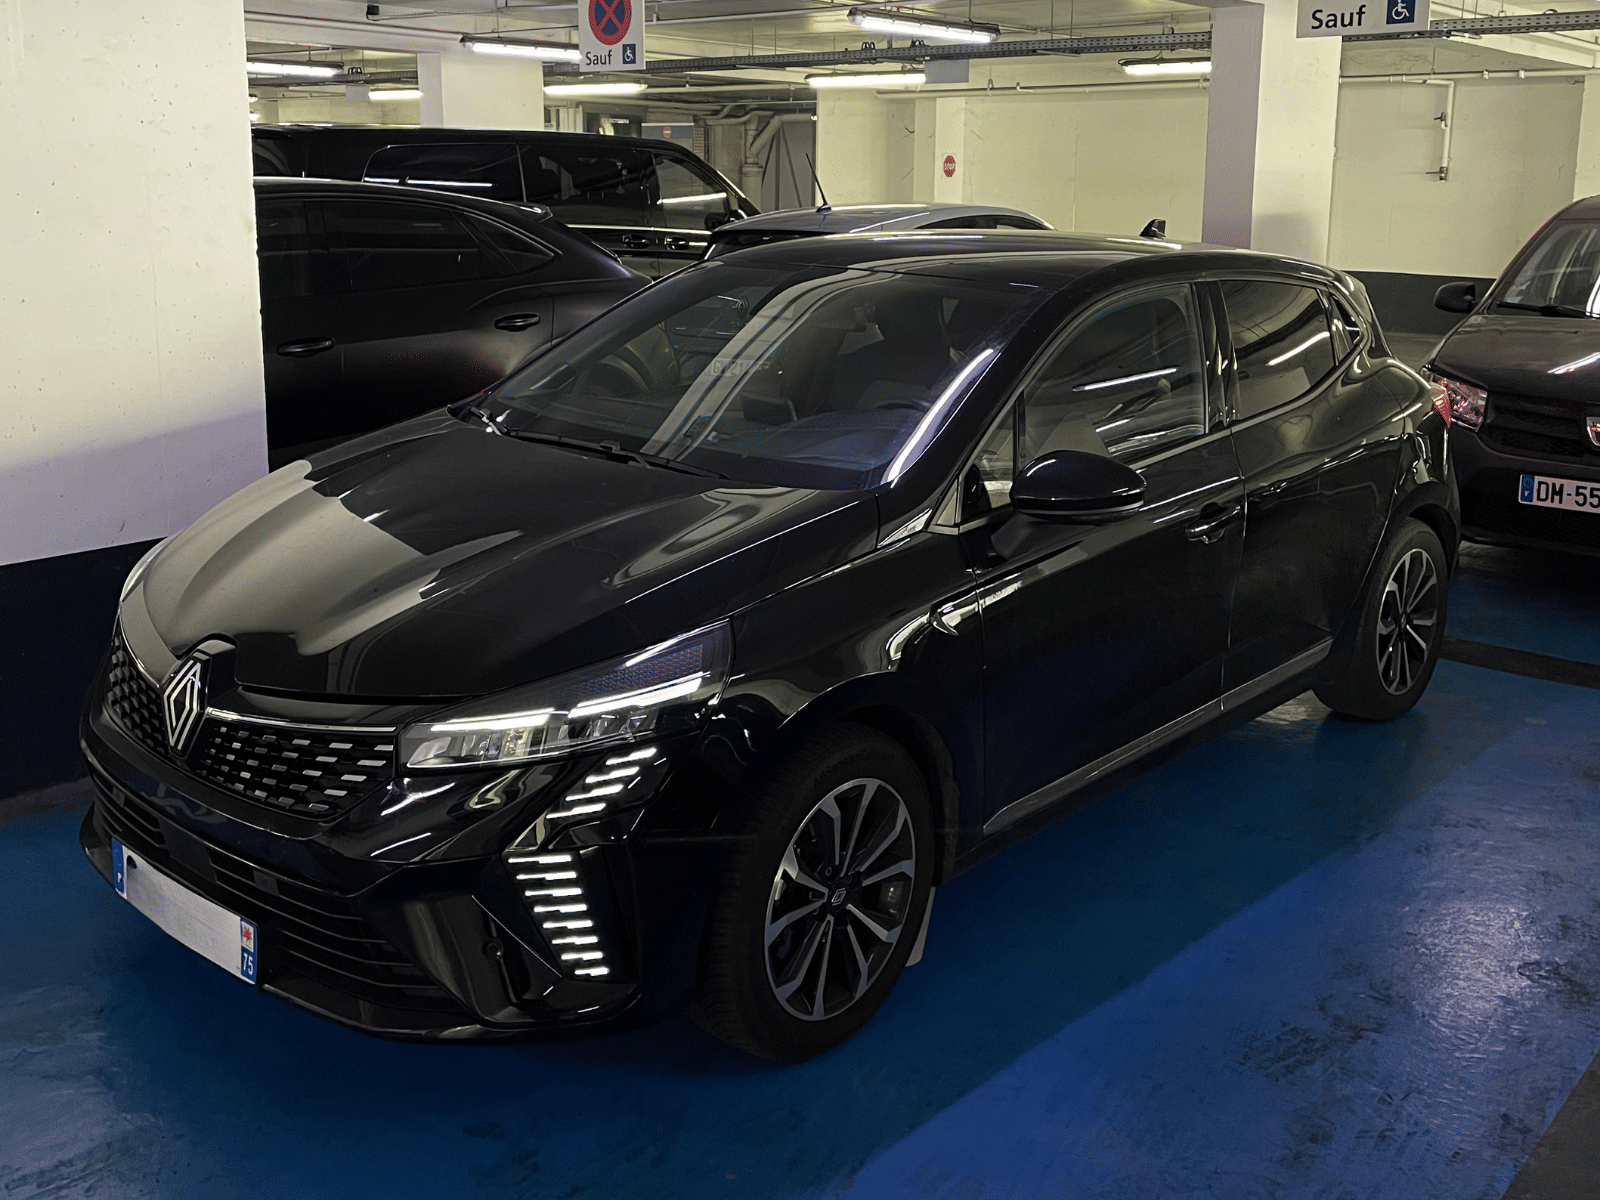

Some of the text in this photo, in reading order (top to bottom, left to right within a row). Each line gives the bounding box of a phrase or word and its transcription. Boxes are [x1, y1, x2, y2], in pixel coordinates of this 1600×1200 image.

[1311, 5, 1367, 29] Sauf
[585, 50, 612, 66] Sauf
[1537, 481, 1600, 508] DM-55
[242, 952, 254, 976] 75
